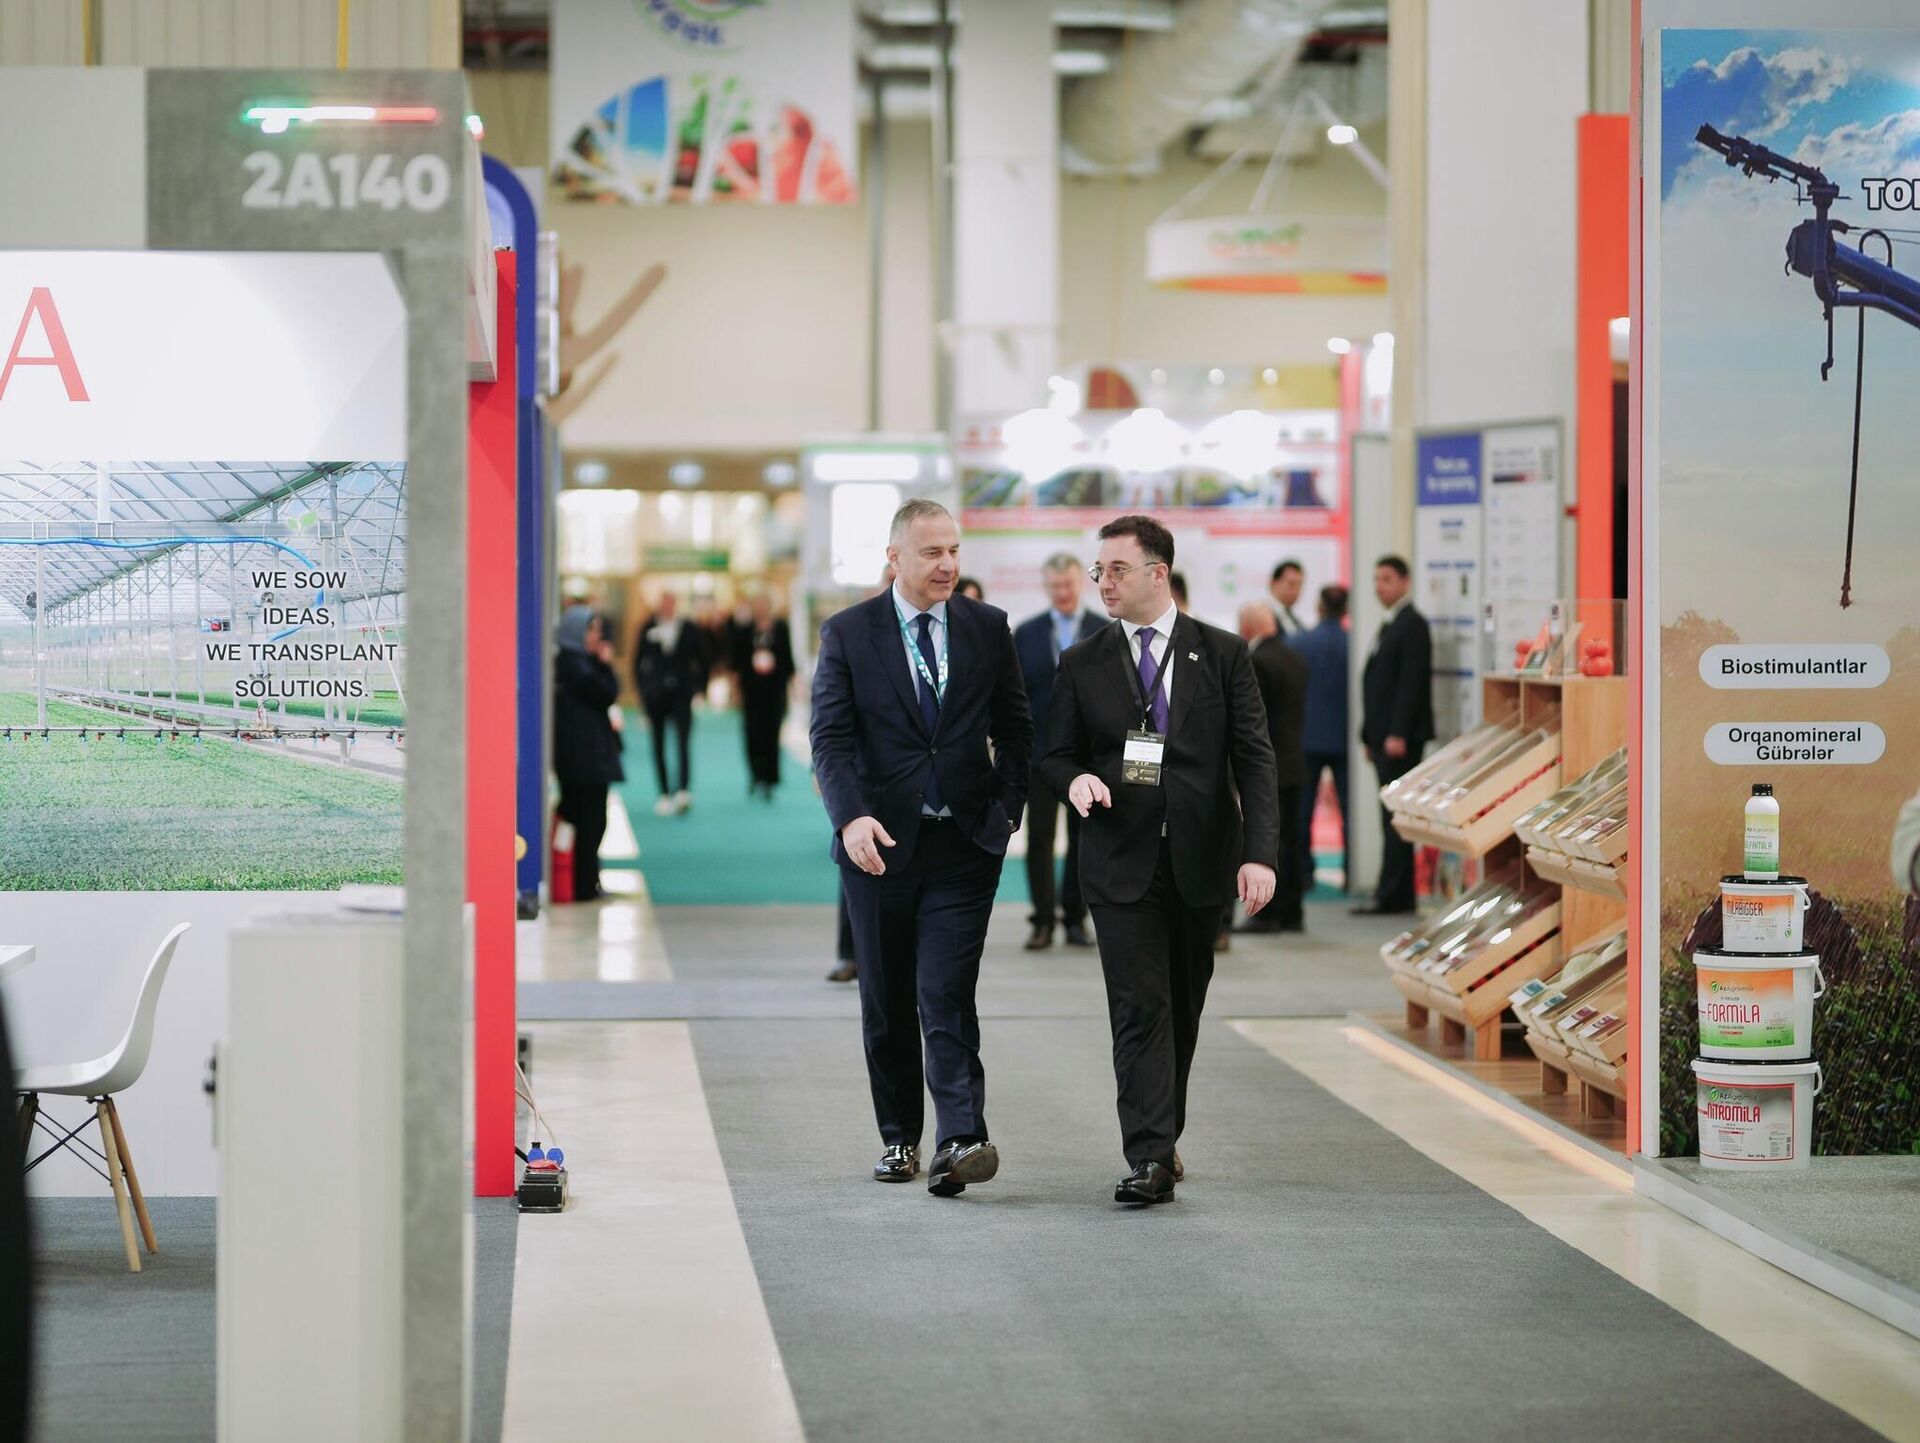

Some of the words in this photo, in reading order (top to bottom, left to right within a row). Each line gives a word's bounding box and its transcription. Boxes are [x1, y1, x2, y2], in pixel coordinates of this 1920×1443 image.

[241, 151, 451, 212] 2A140
[0, 286, 91, 402] A
[252, 571, 287, 589] WE
[294, 571, 347, 589] SOW
[263, 607, 335, 628] IDEAS,
[206, 644, 241, 661] WE
[248, 644, 398, 661] TRANSPLANT
[1721, 658, 1868, 675] Biostimulantlar
[235, 680, 369, 698] SOLUTIONS.
[1729, 727, 1862, 745] Orqanomineral
[1756, 745, 1835, 761] Gübrələr
